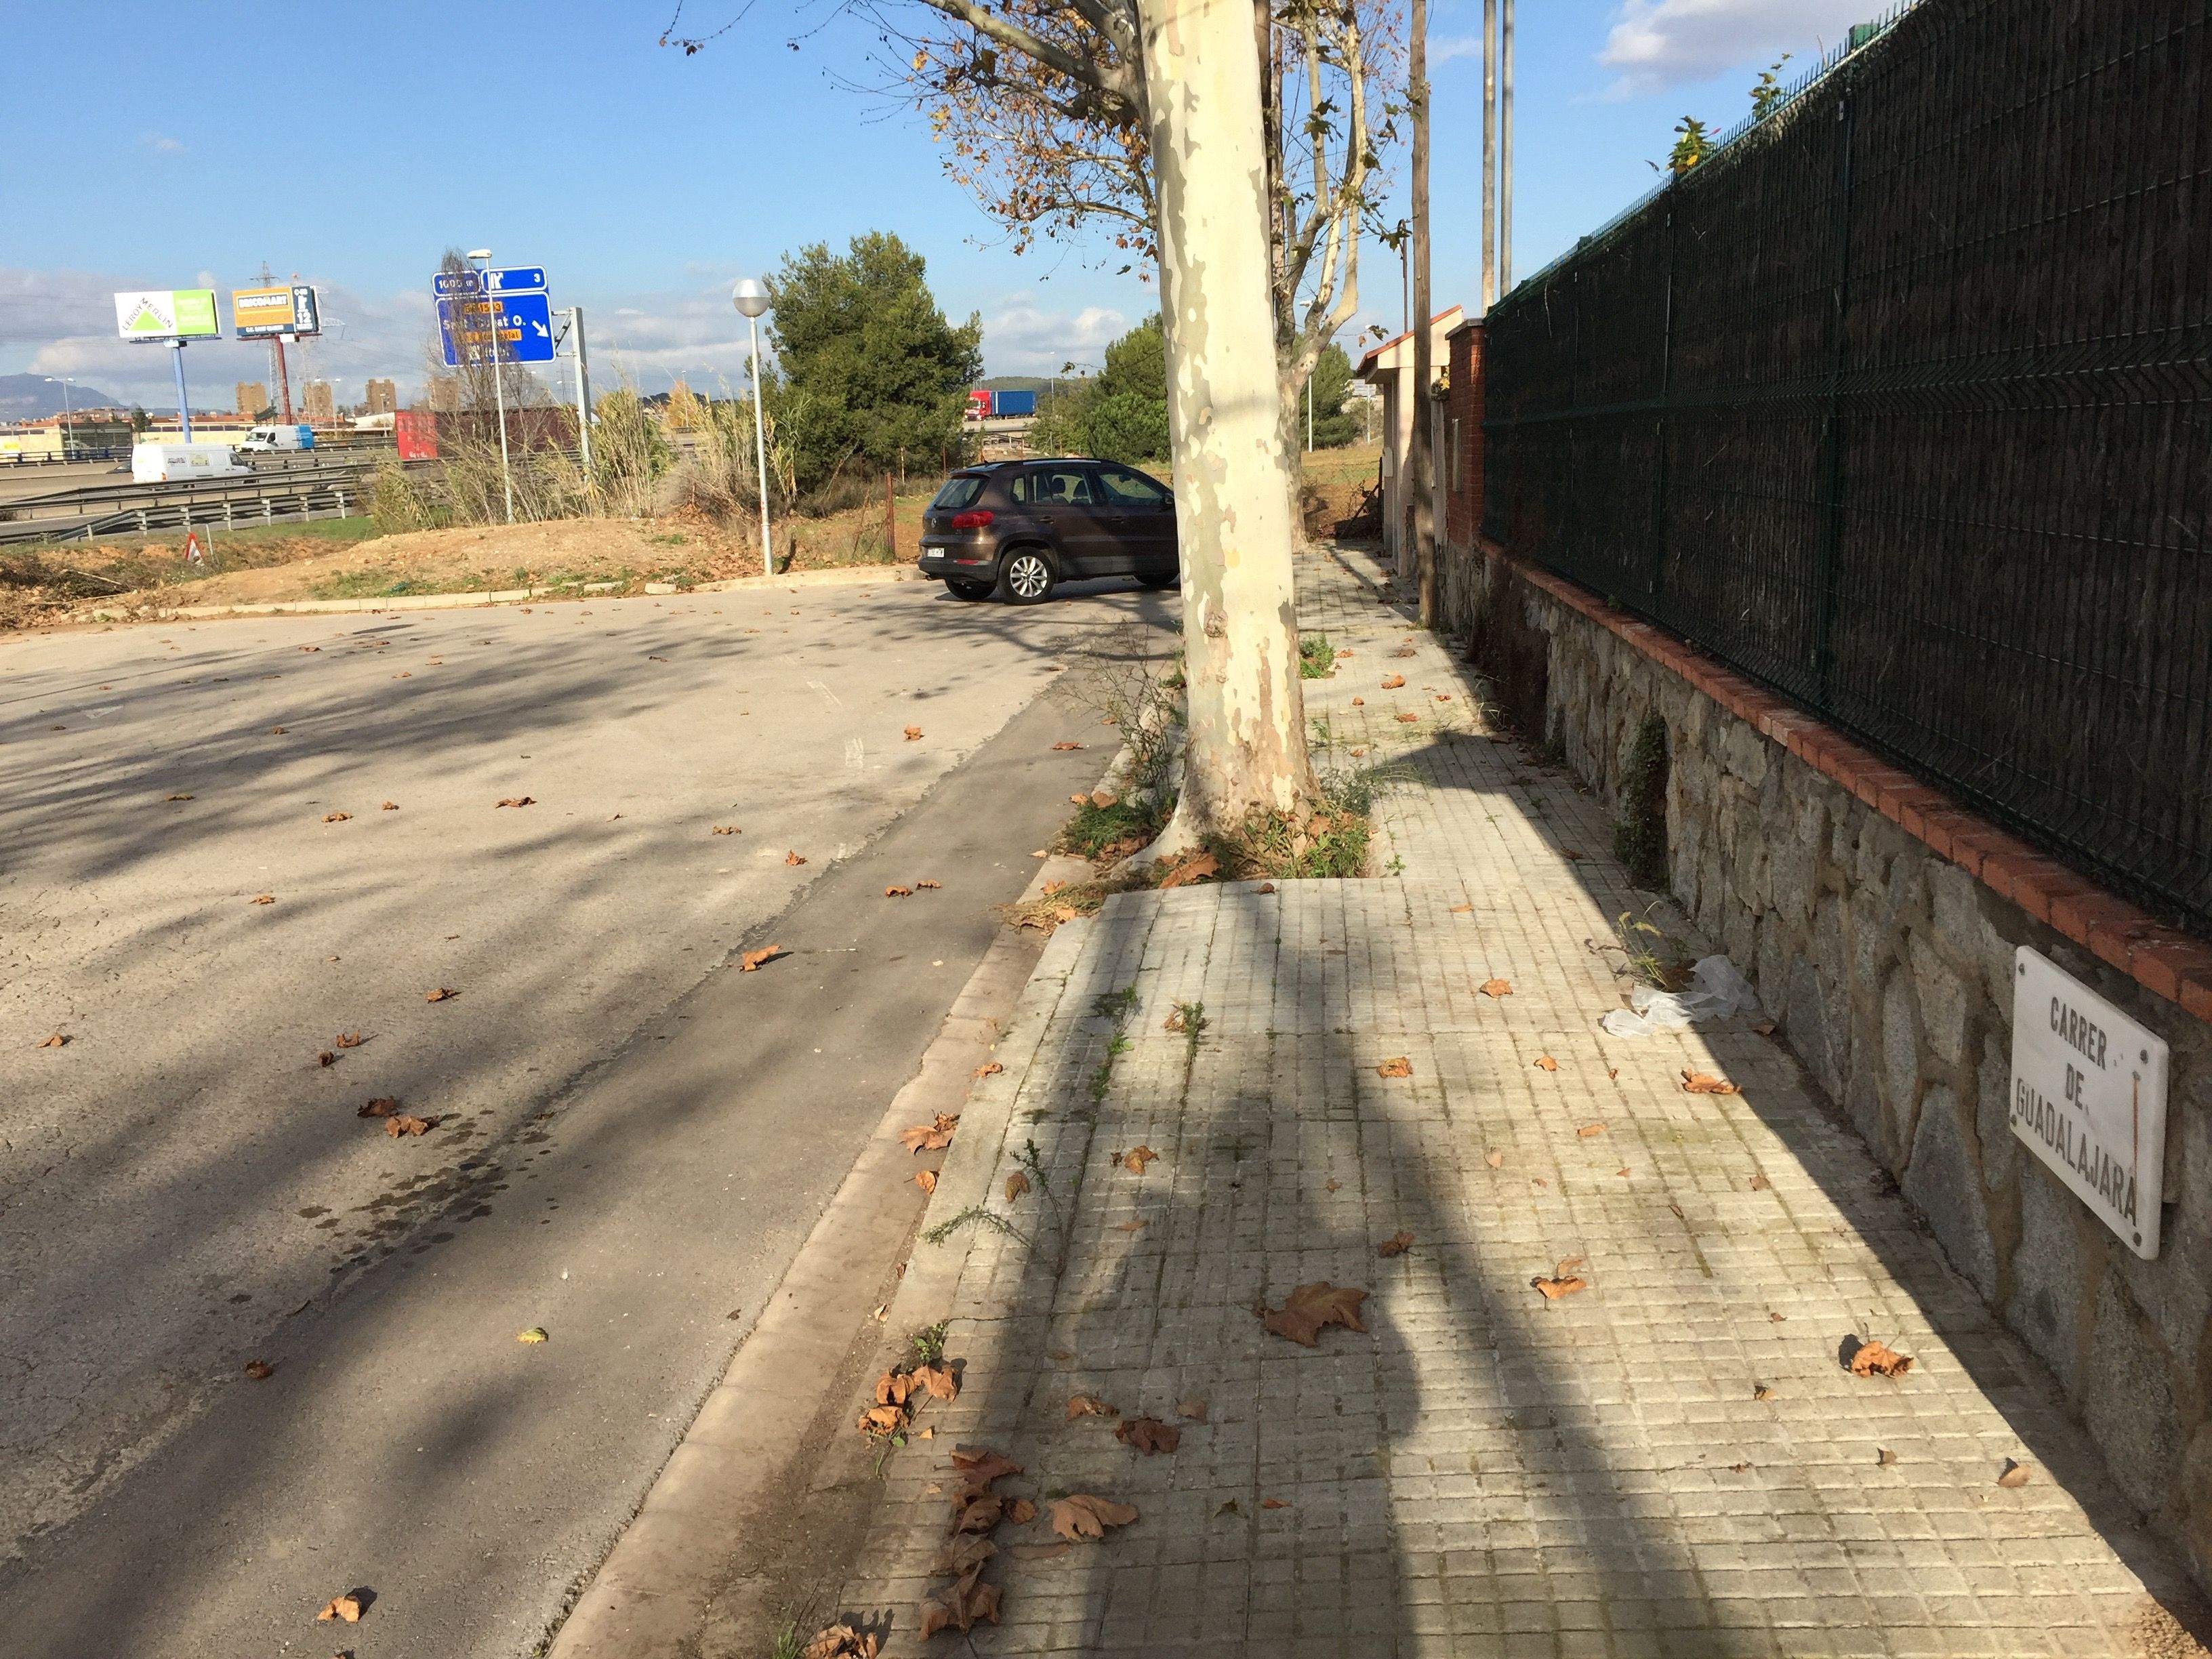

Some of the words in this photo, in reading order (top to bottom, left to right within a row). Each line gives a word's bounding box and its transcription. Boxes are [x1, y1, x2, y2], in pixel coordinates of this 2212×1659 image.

[533, 273, 541, 283] 3
[122, 304, 142, 331] LEROY
[140, 297, 173, 329] MERLIN
[297, 312, 312, 324] 12
[2050, 997, 2107, 1070] CARRER
[2065, 1063, 2085, 1112] DE
[2016, 1079, 2137, 1227] GUADALAJARA
